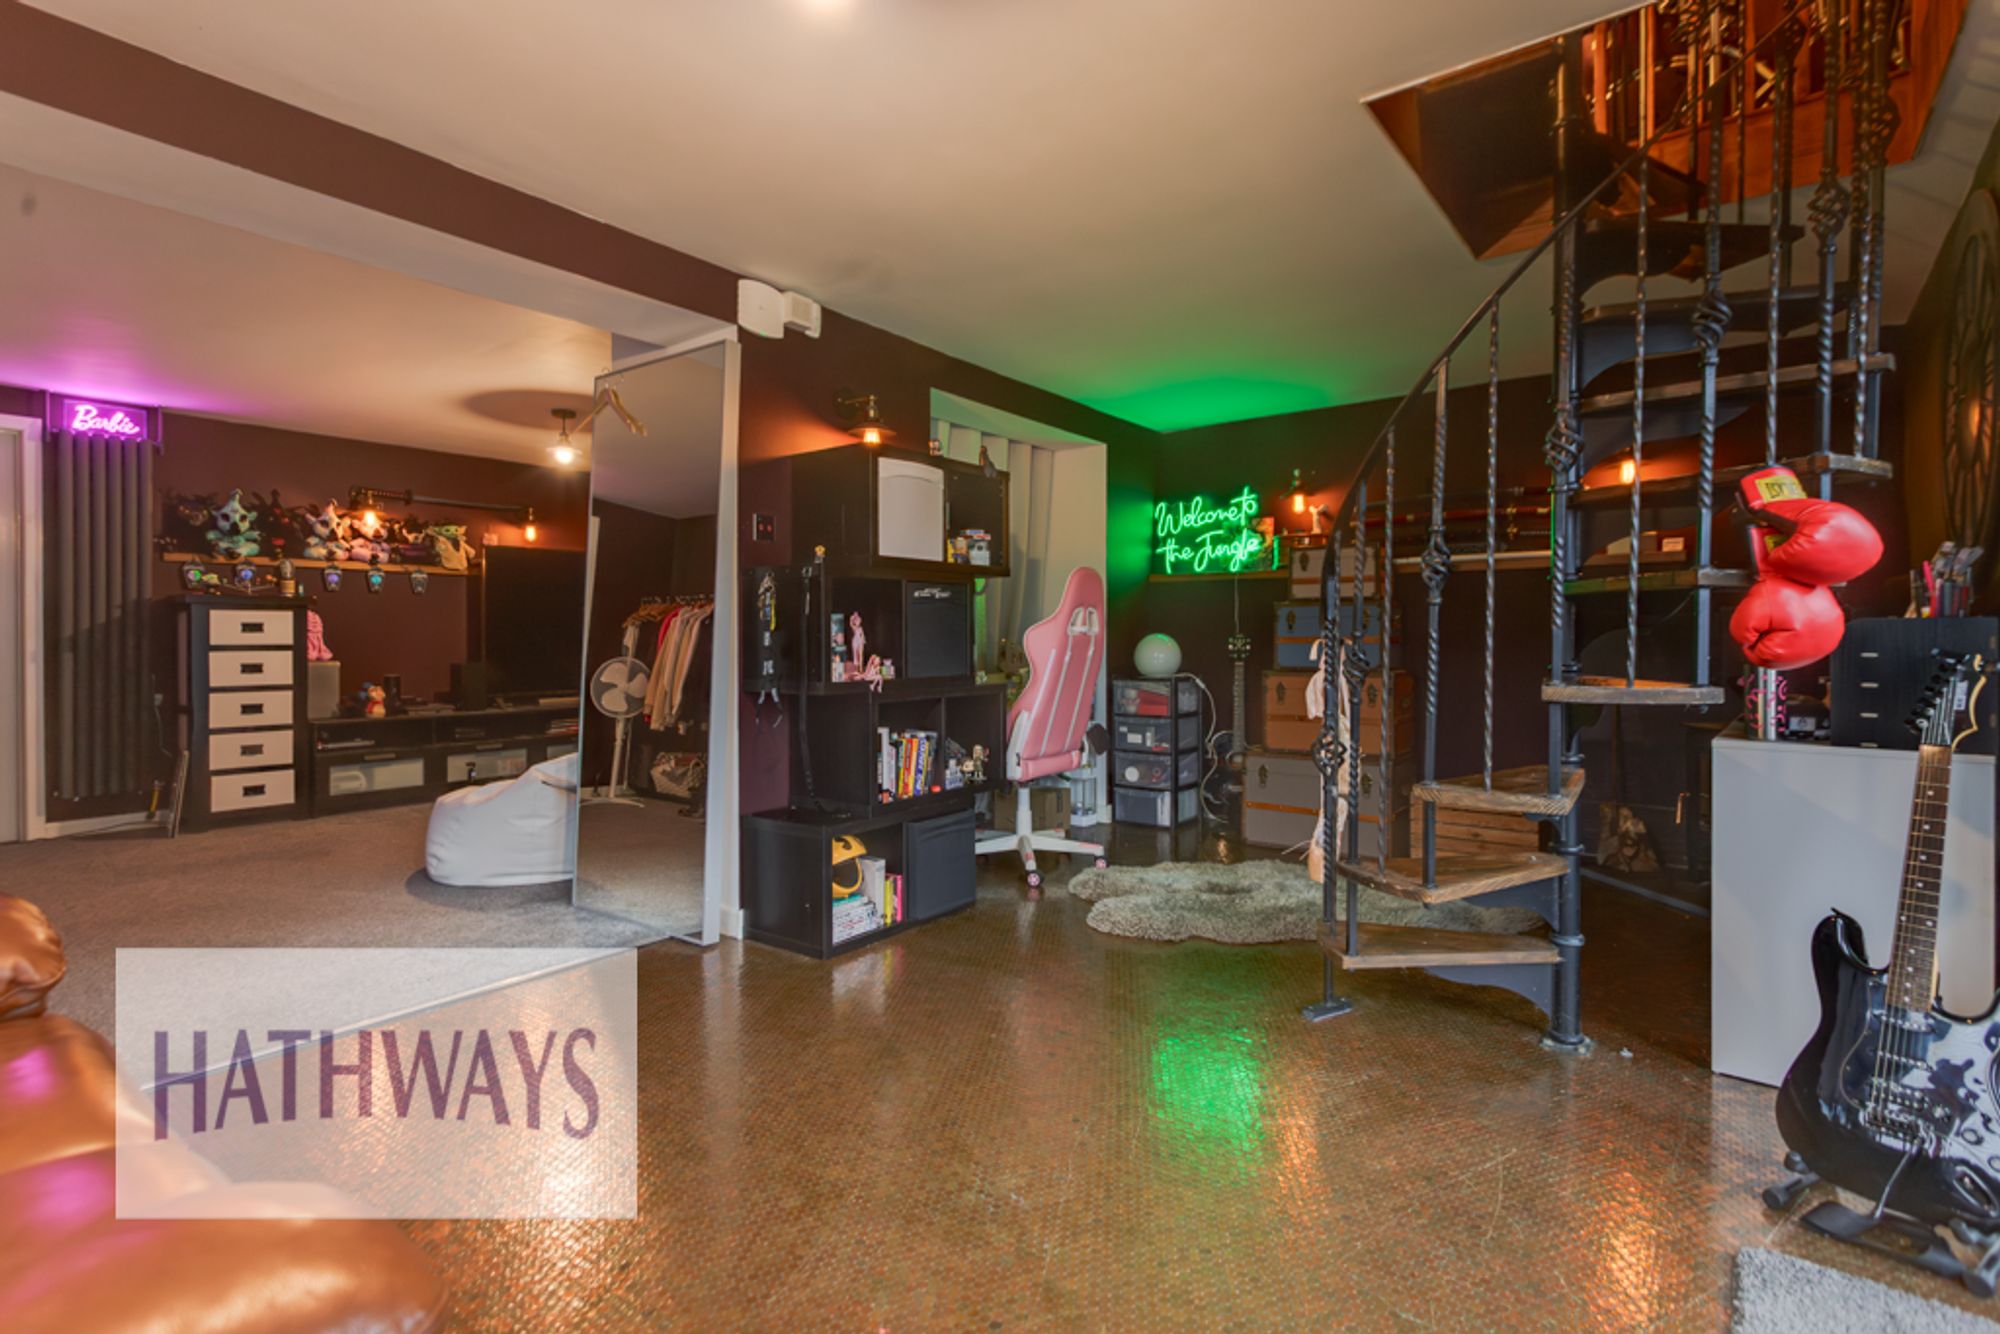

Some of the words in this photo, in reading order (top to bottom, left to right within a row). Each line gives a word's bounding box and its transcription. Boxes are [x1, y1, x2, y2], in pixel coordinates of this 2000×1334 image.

[71, 404, 140, 434] Barbie
[1154, 496, 1241, 537] Welcome
[1230, 486, 1258, 526] to
[1155, 538, 1194, 574] the
[1193, 527, 1259, 572] Jungle
